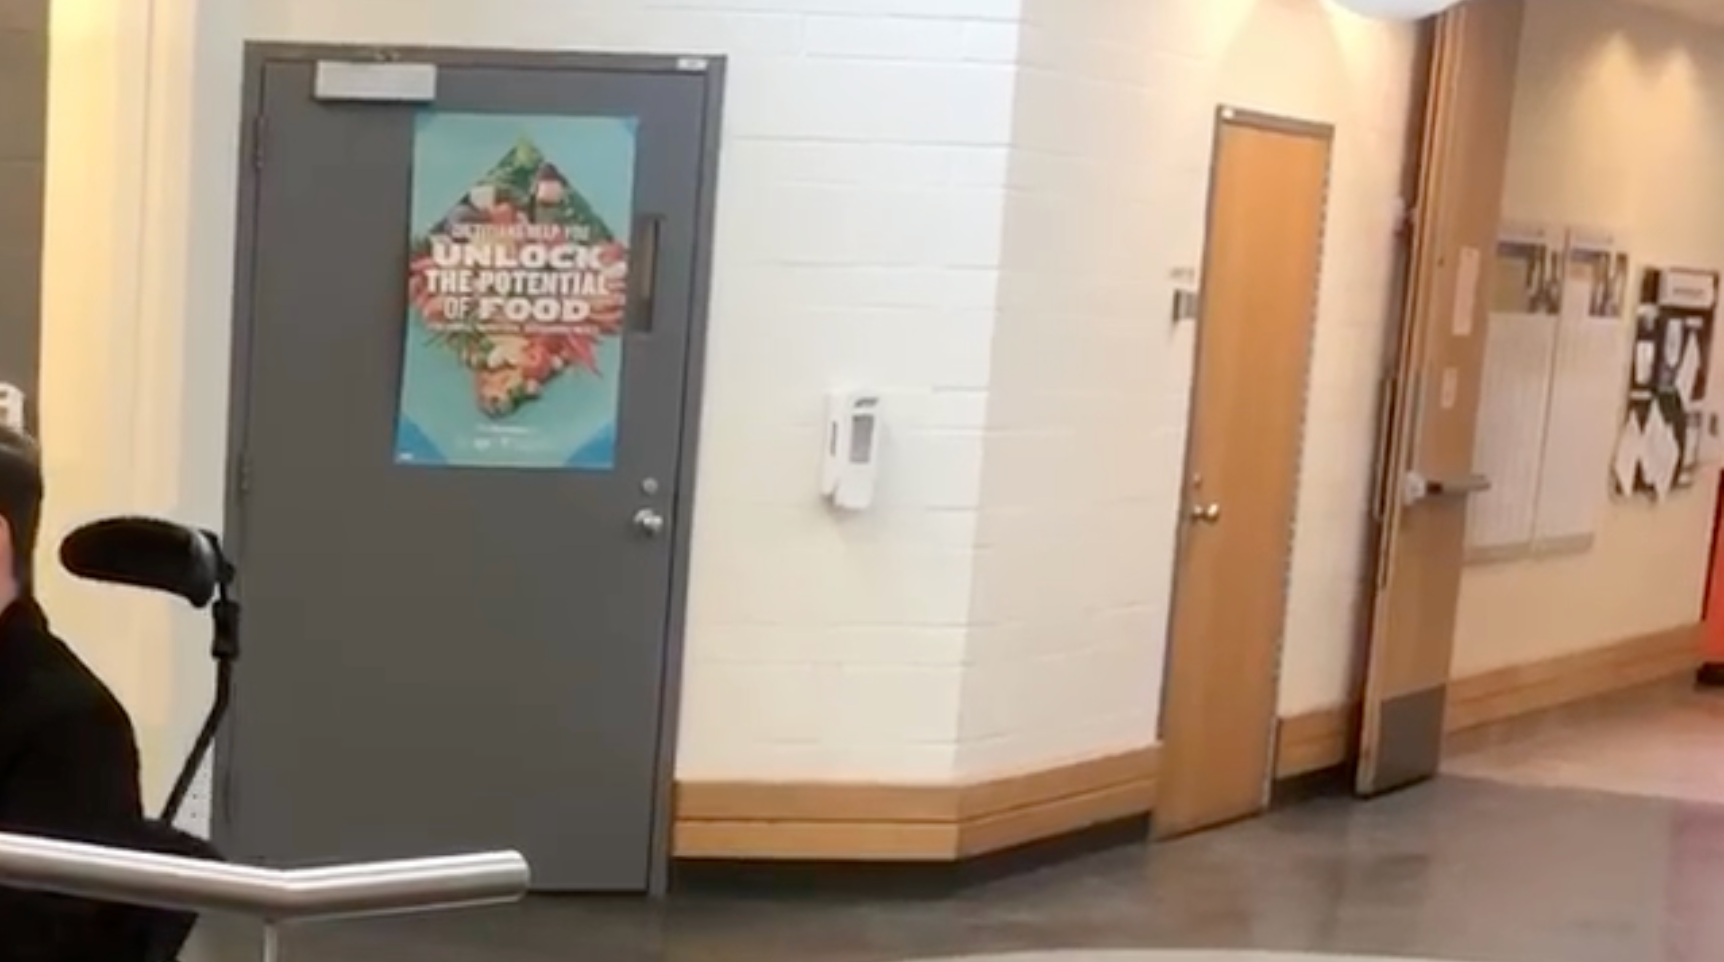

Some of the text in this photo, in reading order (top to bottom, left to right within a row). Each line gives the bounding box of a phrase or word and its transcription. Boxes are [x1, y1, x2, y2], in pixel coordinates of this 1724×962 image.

[431, 242, 601, 269] UNLOCK
[425, 269, 608, 295] THE POTENTIAL
[443, 297, 592, 322] OF FOOD
